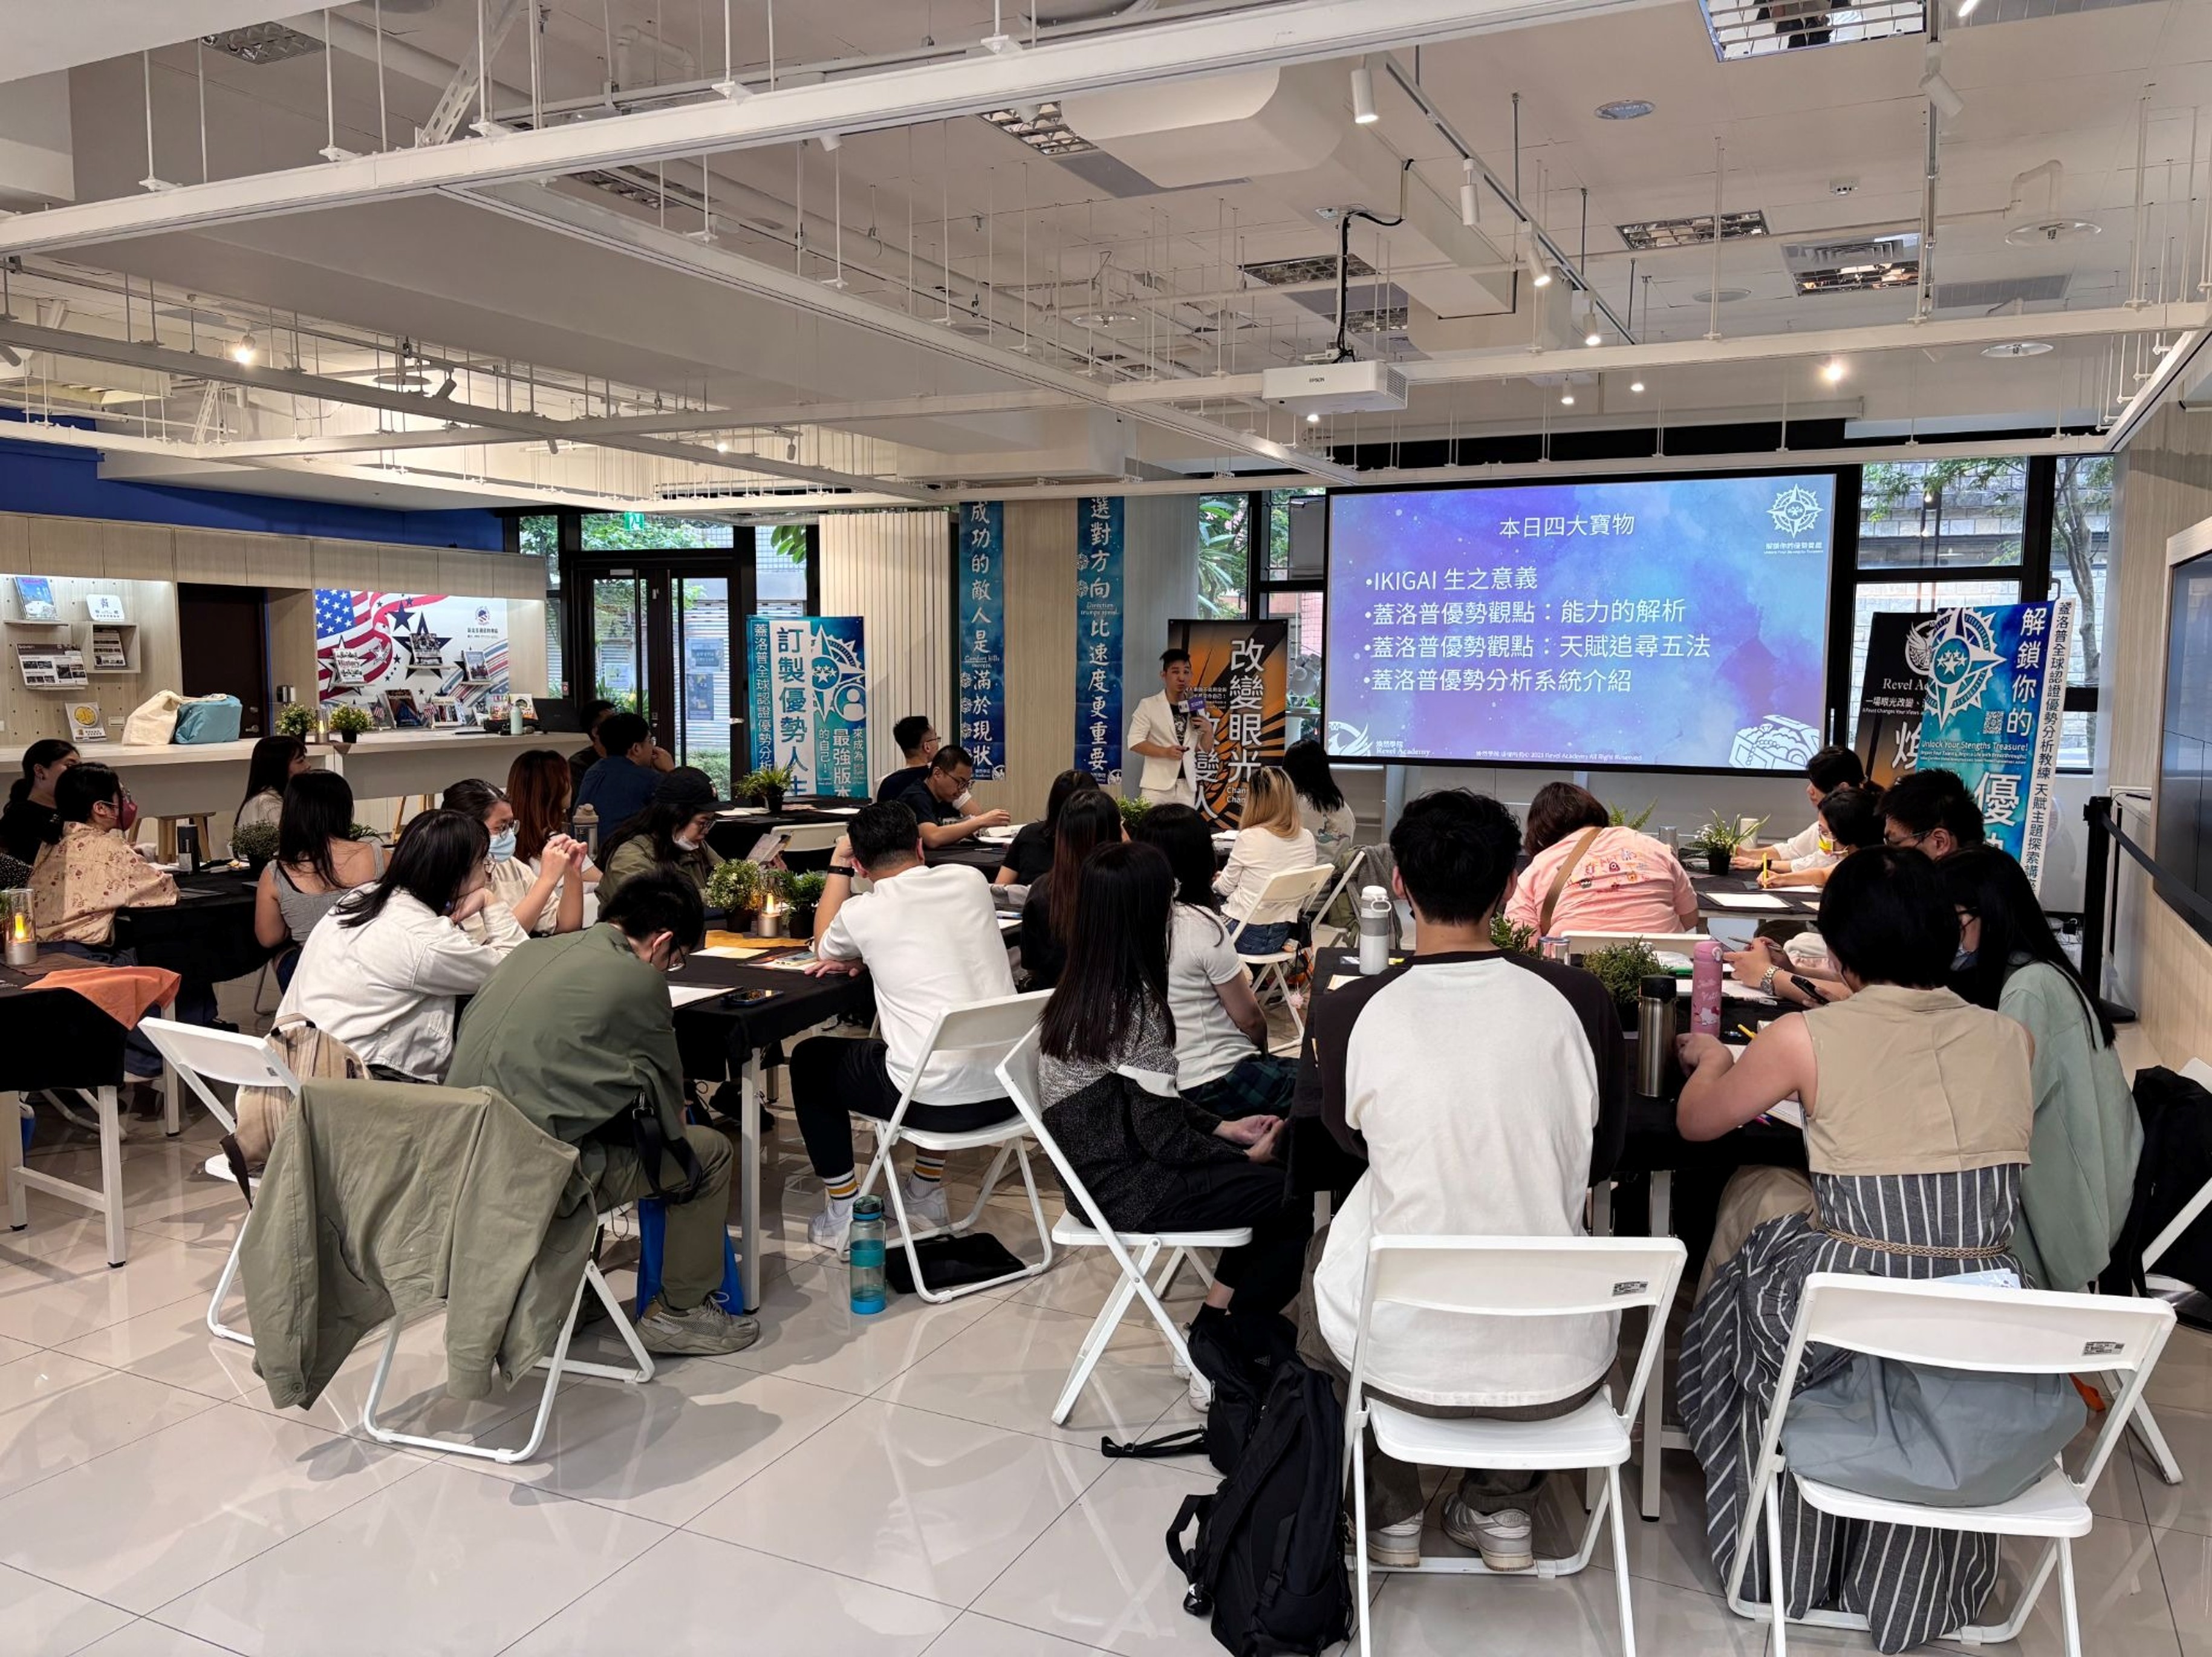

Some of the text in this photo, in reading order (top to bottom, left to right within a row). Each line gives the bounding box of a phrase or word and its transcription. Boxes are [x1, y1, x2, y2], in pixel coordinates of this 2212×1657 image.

[1499, 513, 1635, 539] 本日四大寶物
[1374, 565, 1538, 591] IKIGAI 生之意義
[1371, 668, 1632, 692] 蓋洛普優勢分析系統介紹
[1882, 678, 1913, 691] Revel
[2006, 607, 2048, 737] 解鎖你的
[1921, 739, 1942, 748] Unlock
[1943, 740, 1959, 749] Your
[1992, 741, 2029, 752] Treasure!
